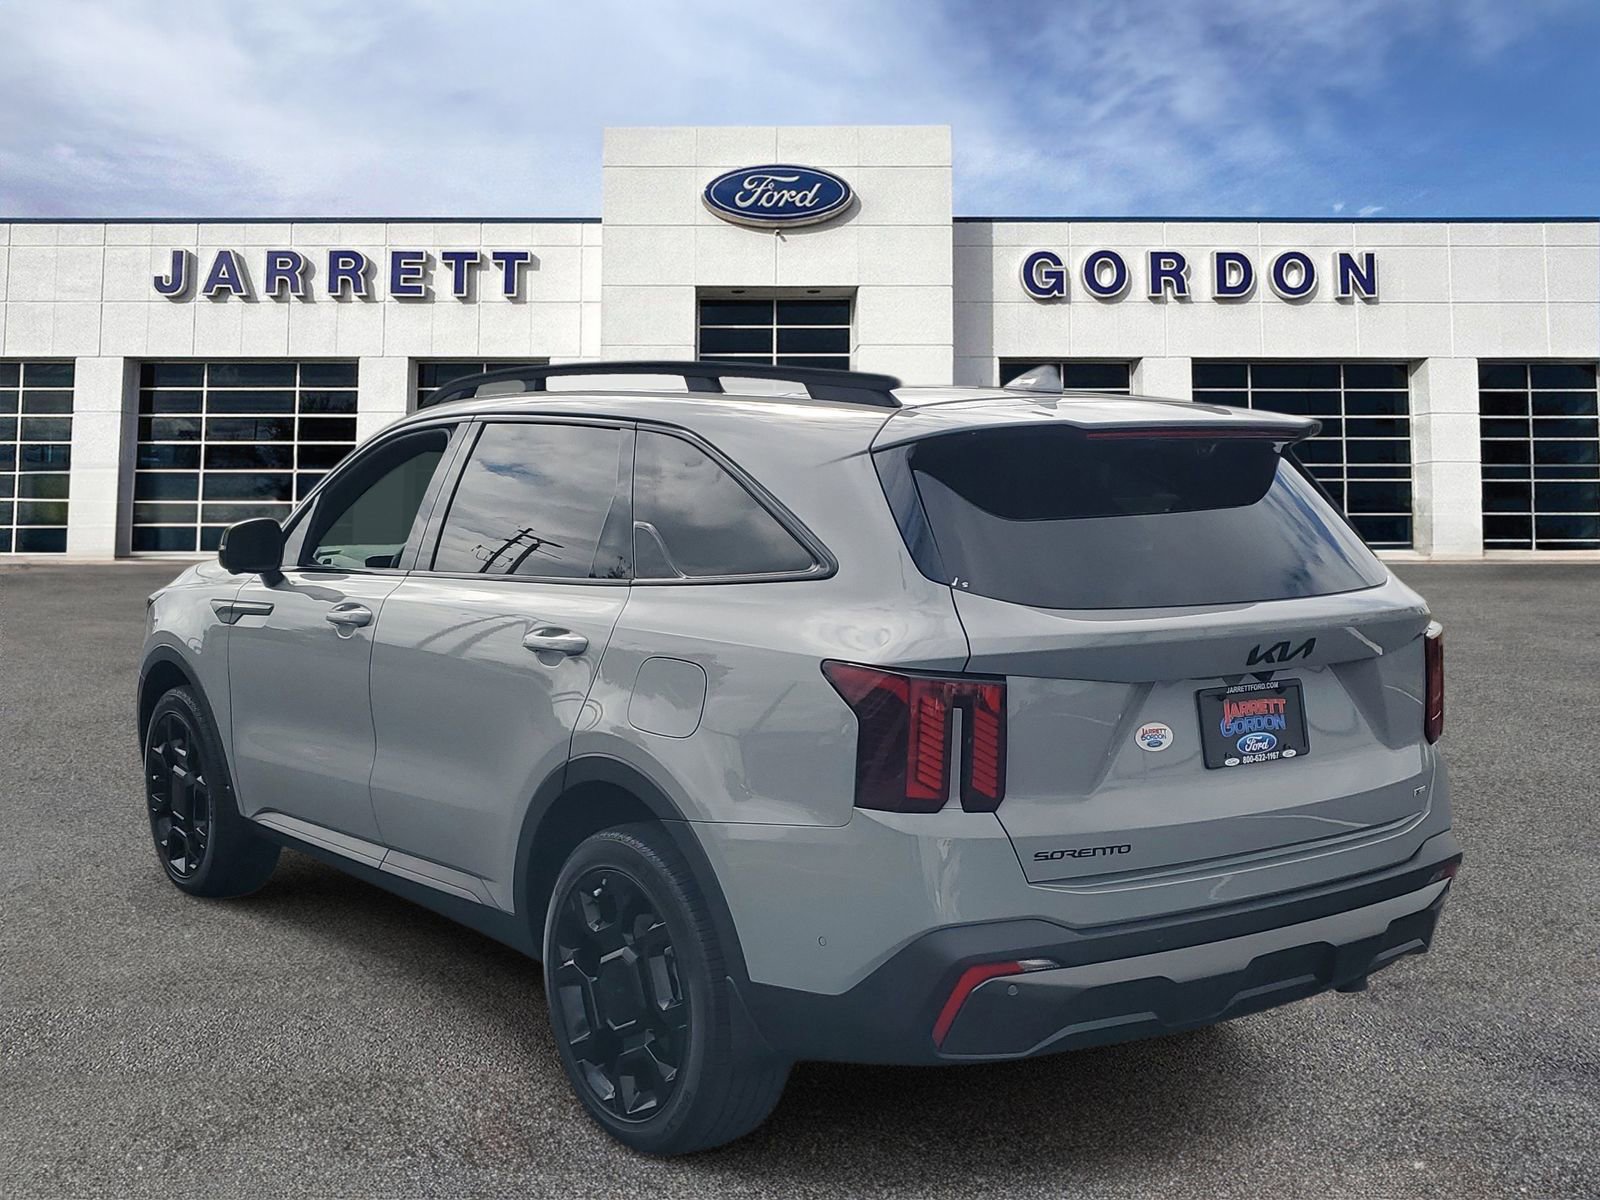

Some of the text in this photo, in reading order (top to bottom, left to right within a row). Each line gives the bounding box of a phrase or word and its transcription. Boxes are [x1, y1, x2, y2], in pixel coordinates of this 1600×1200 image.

[735, 174, 821, 207] Ford
[154, 249, 532, 299] JARRETT
[1022, 250, 1378, 300] GORDON
[1226, 682, 1279, 693] JARRETTFORD.COM
[1220, 714, 1287, 737] GORDON
[1224, 698, 1286, 728] JARRETT
[1245, 736, 1269, 752] Ford
[1033, 844, 1132, 862] SORENTO
